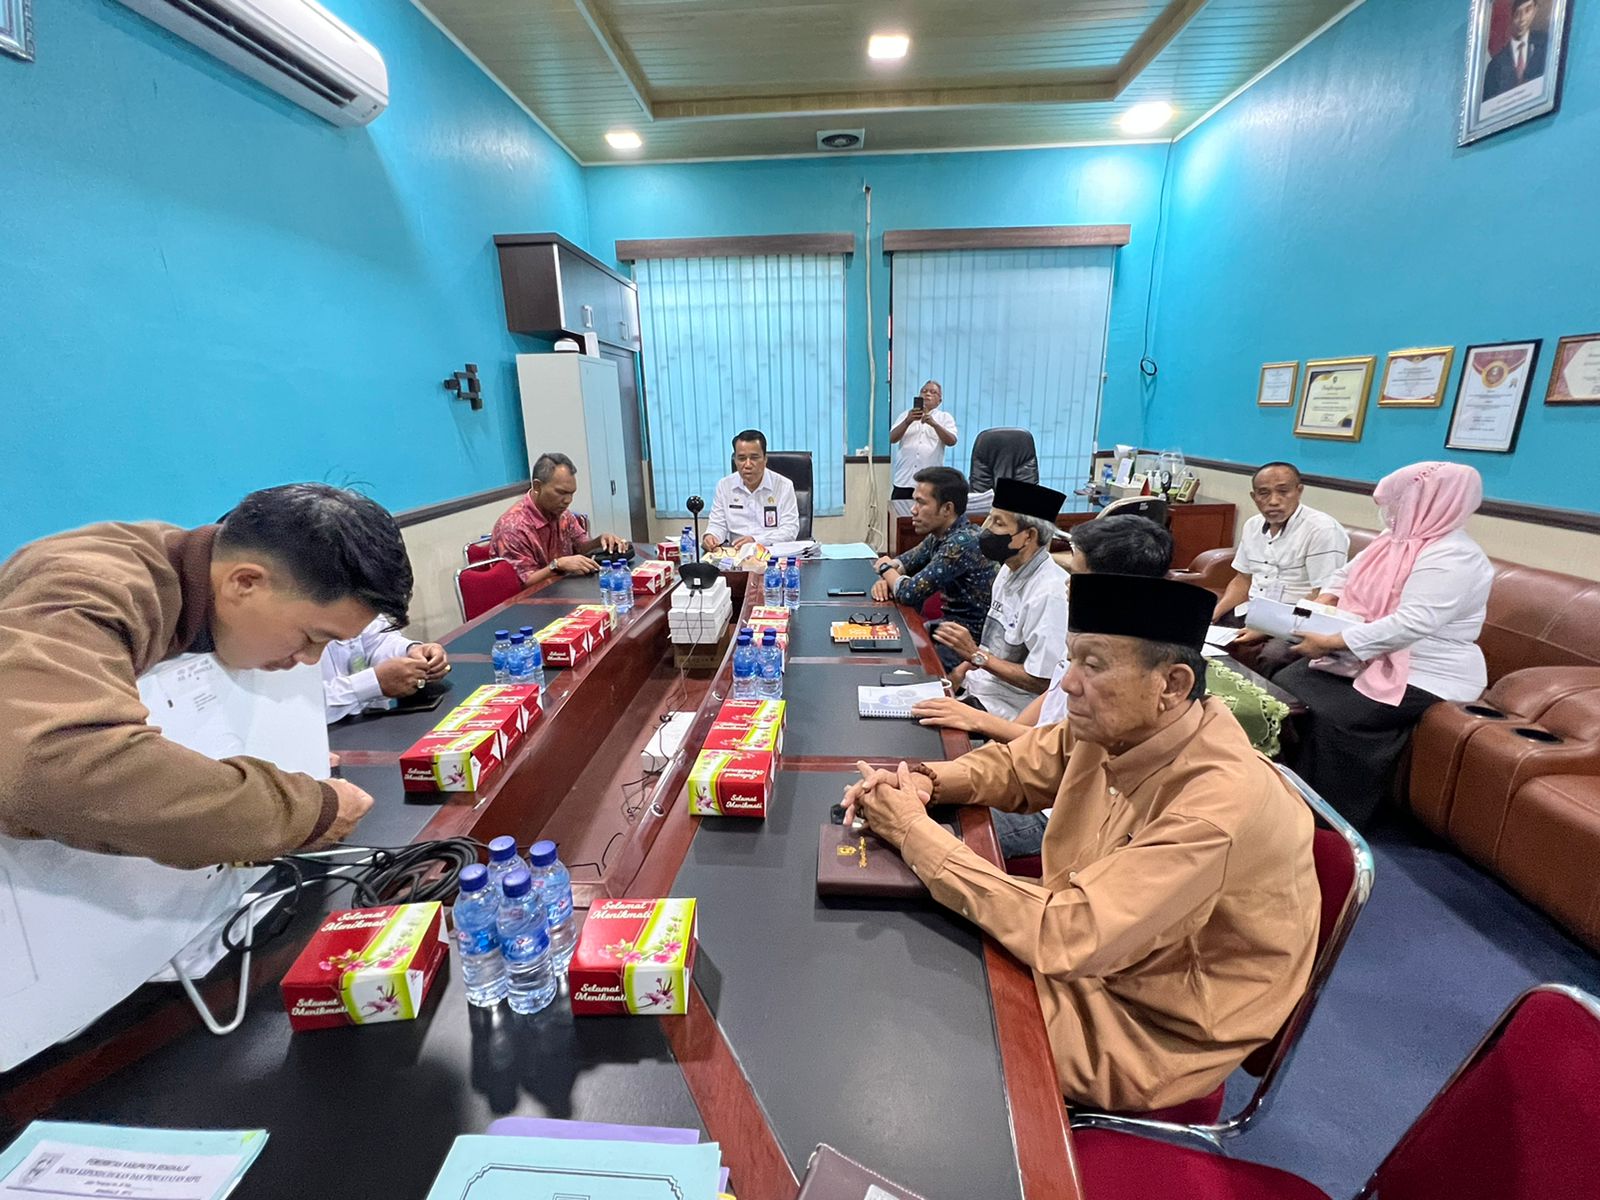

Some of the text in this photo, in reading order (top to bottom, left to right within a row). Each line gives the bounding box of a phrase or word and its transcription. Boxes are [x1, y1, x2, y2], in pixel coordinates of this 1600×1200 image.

[730, 794, 757, 802] Selamat
[726, 801, 762, 809] Menikmati
[602, 901, 646, 910] Selamat
[337, 910, 387, 922] Selamat
[590, 910, 653, 919] Menikmati
[321, 917, 391, 932] Menikmati
[580, 983, 621, 992] Selamat
[574, 991, 627, 1002] Menikmati
[296, 998, 340, 1007] Selamat
[291, 1006, 348, 1016] Menikmati
